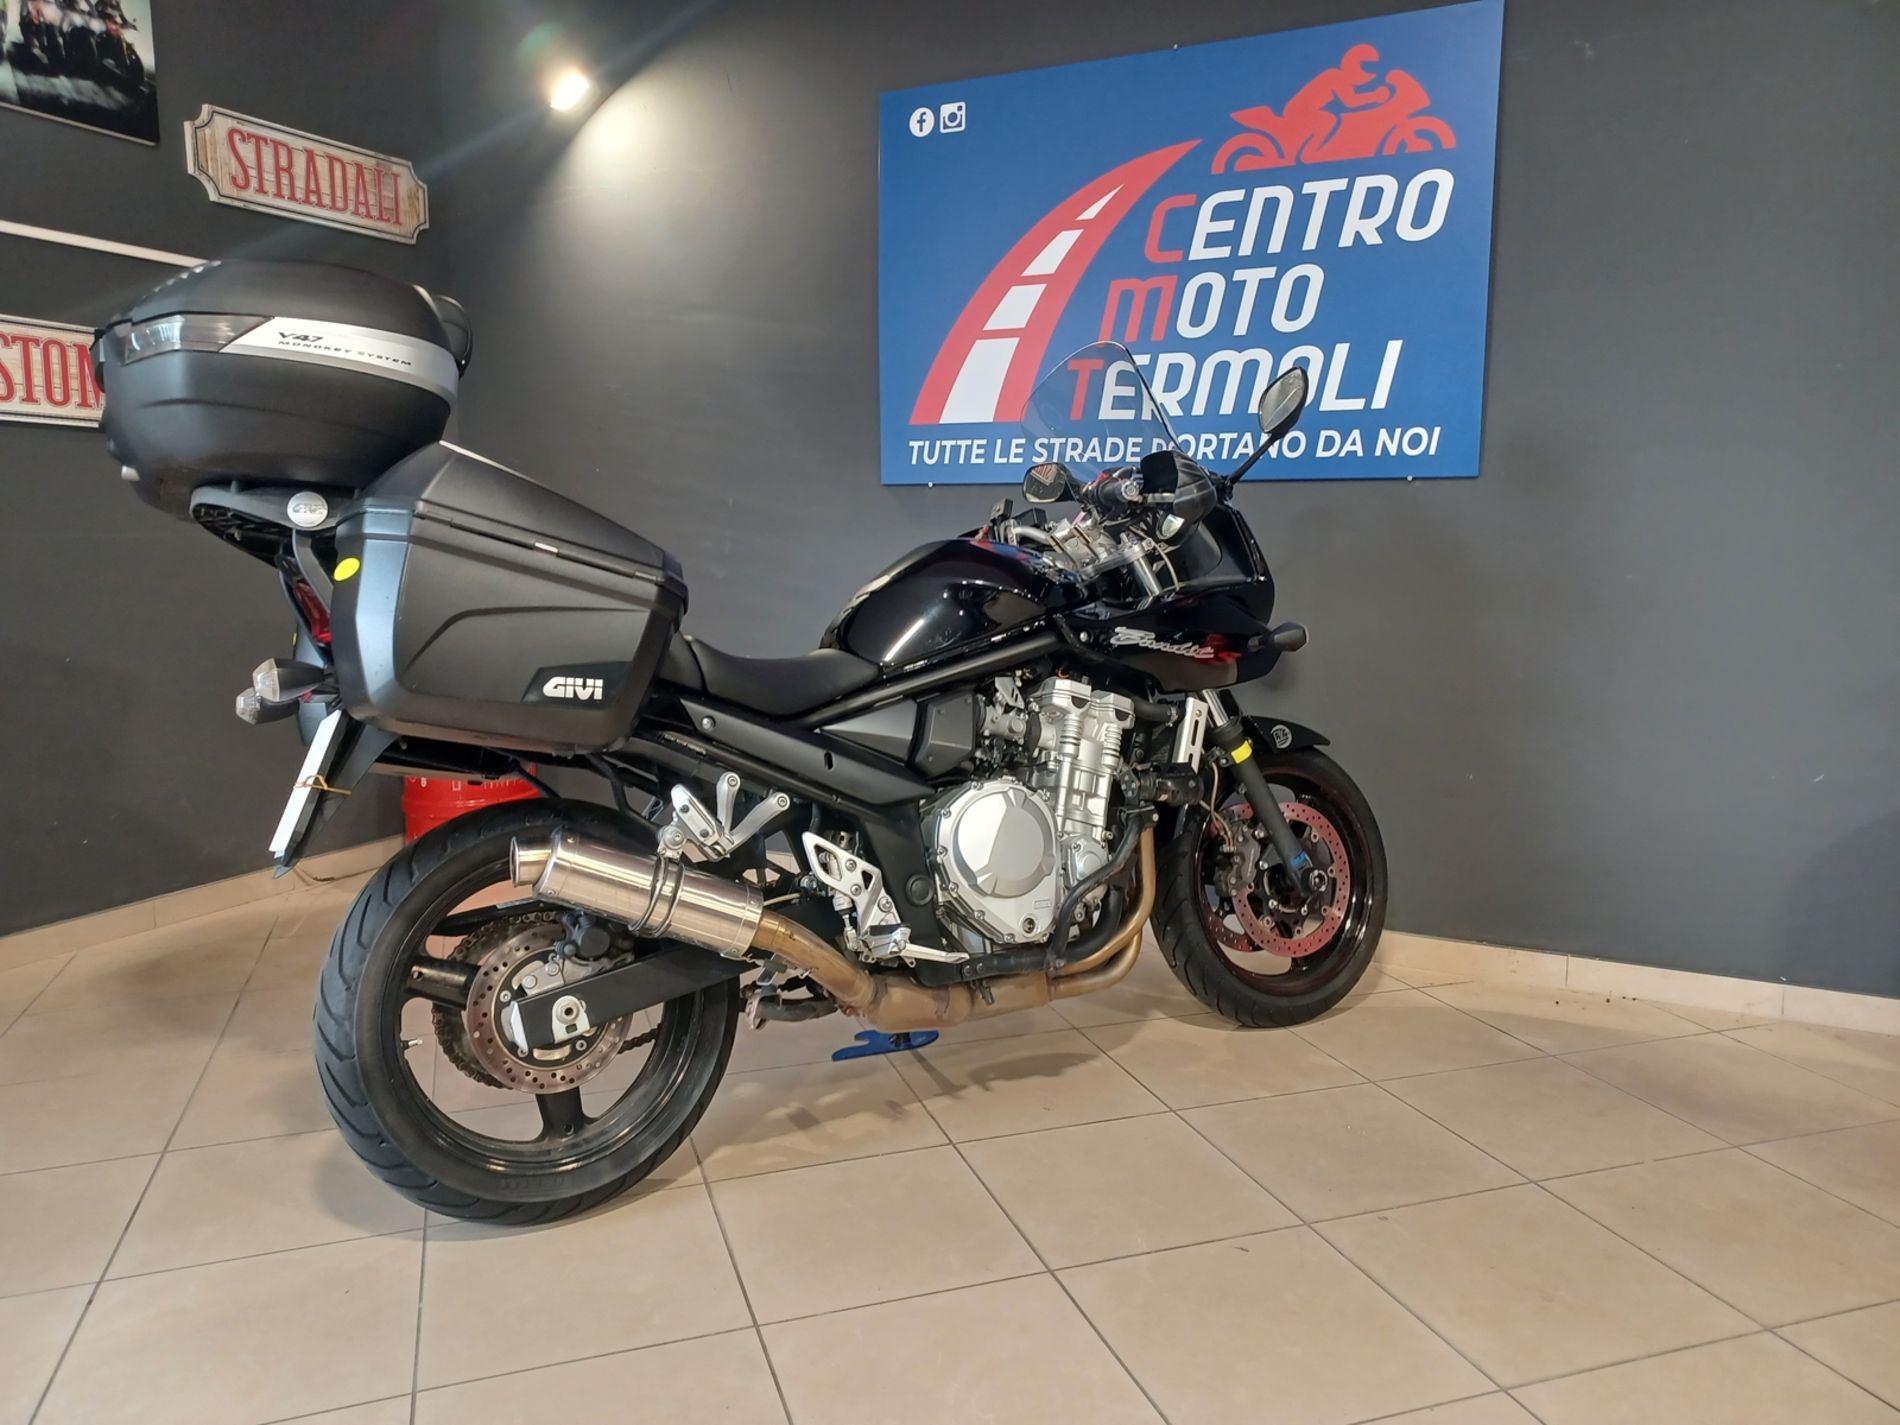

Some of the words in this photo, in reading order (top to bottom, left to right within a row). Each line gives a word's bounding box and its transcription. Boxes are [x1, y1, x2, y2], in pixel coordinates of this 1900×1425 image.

[227, 127, 402, 225] STRADALI
[1144, 168, 1455, 264] CENTRO
[1095, 263, 1325, 347] MOTO
[278, 331, 324, 343] V47
[278, 340, 353, 354] MONOKEY
[908, 439, 987, 465] TUTTE
[993, 438, 1027, 464] LE
[1032, 437, 1143, 464] STRADE
[1315, 428, 1364, 458] DA
[1374, 426, 1441, 457] NOI
[542, 676, 604, 701] GIVI
